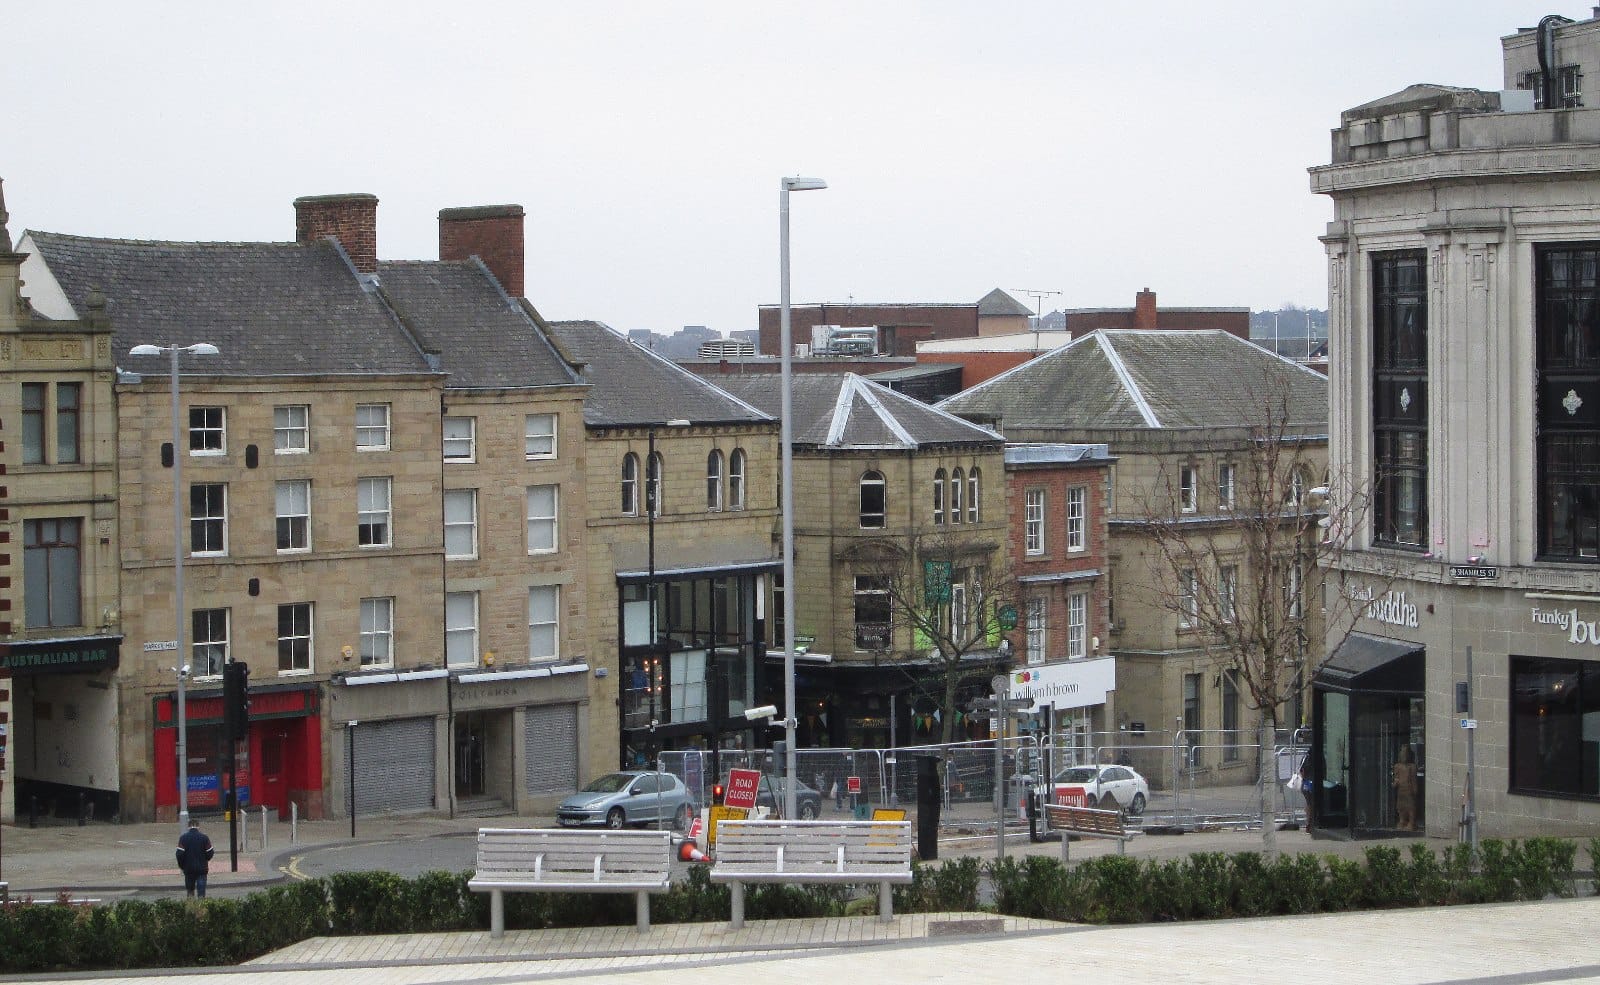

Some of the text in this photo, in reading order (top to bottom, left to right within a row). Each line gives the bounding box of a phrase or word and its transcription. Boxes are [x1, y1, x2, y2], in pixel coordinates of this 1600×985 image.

[1488, 569, 1495, 577] ST
[1531, 607, 1570, 631] Funky
[2, 649, 107, 667] AUSTRALIAN BAR
[1015, 682, 1079, 700] william h brown
[735, 778, 753, 789] ROAD
[729, 789, 754, 800] CLOSED
